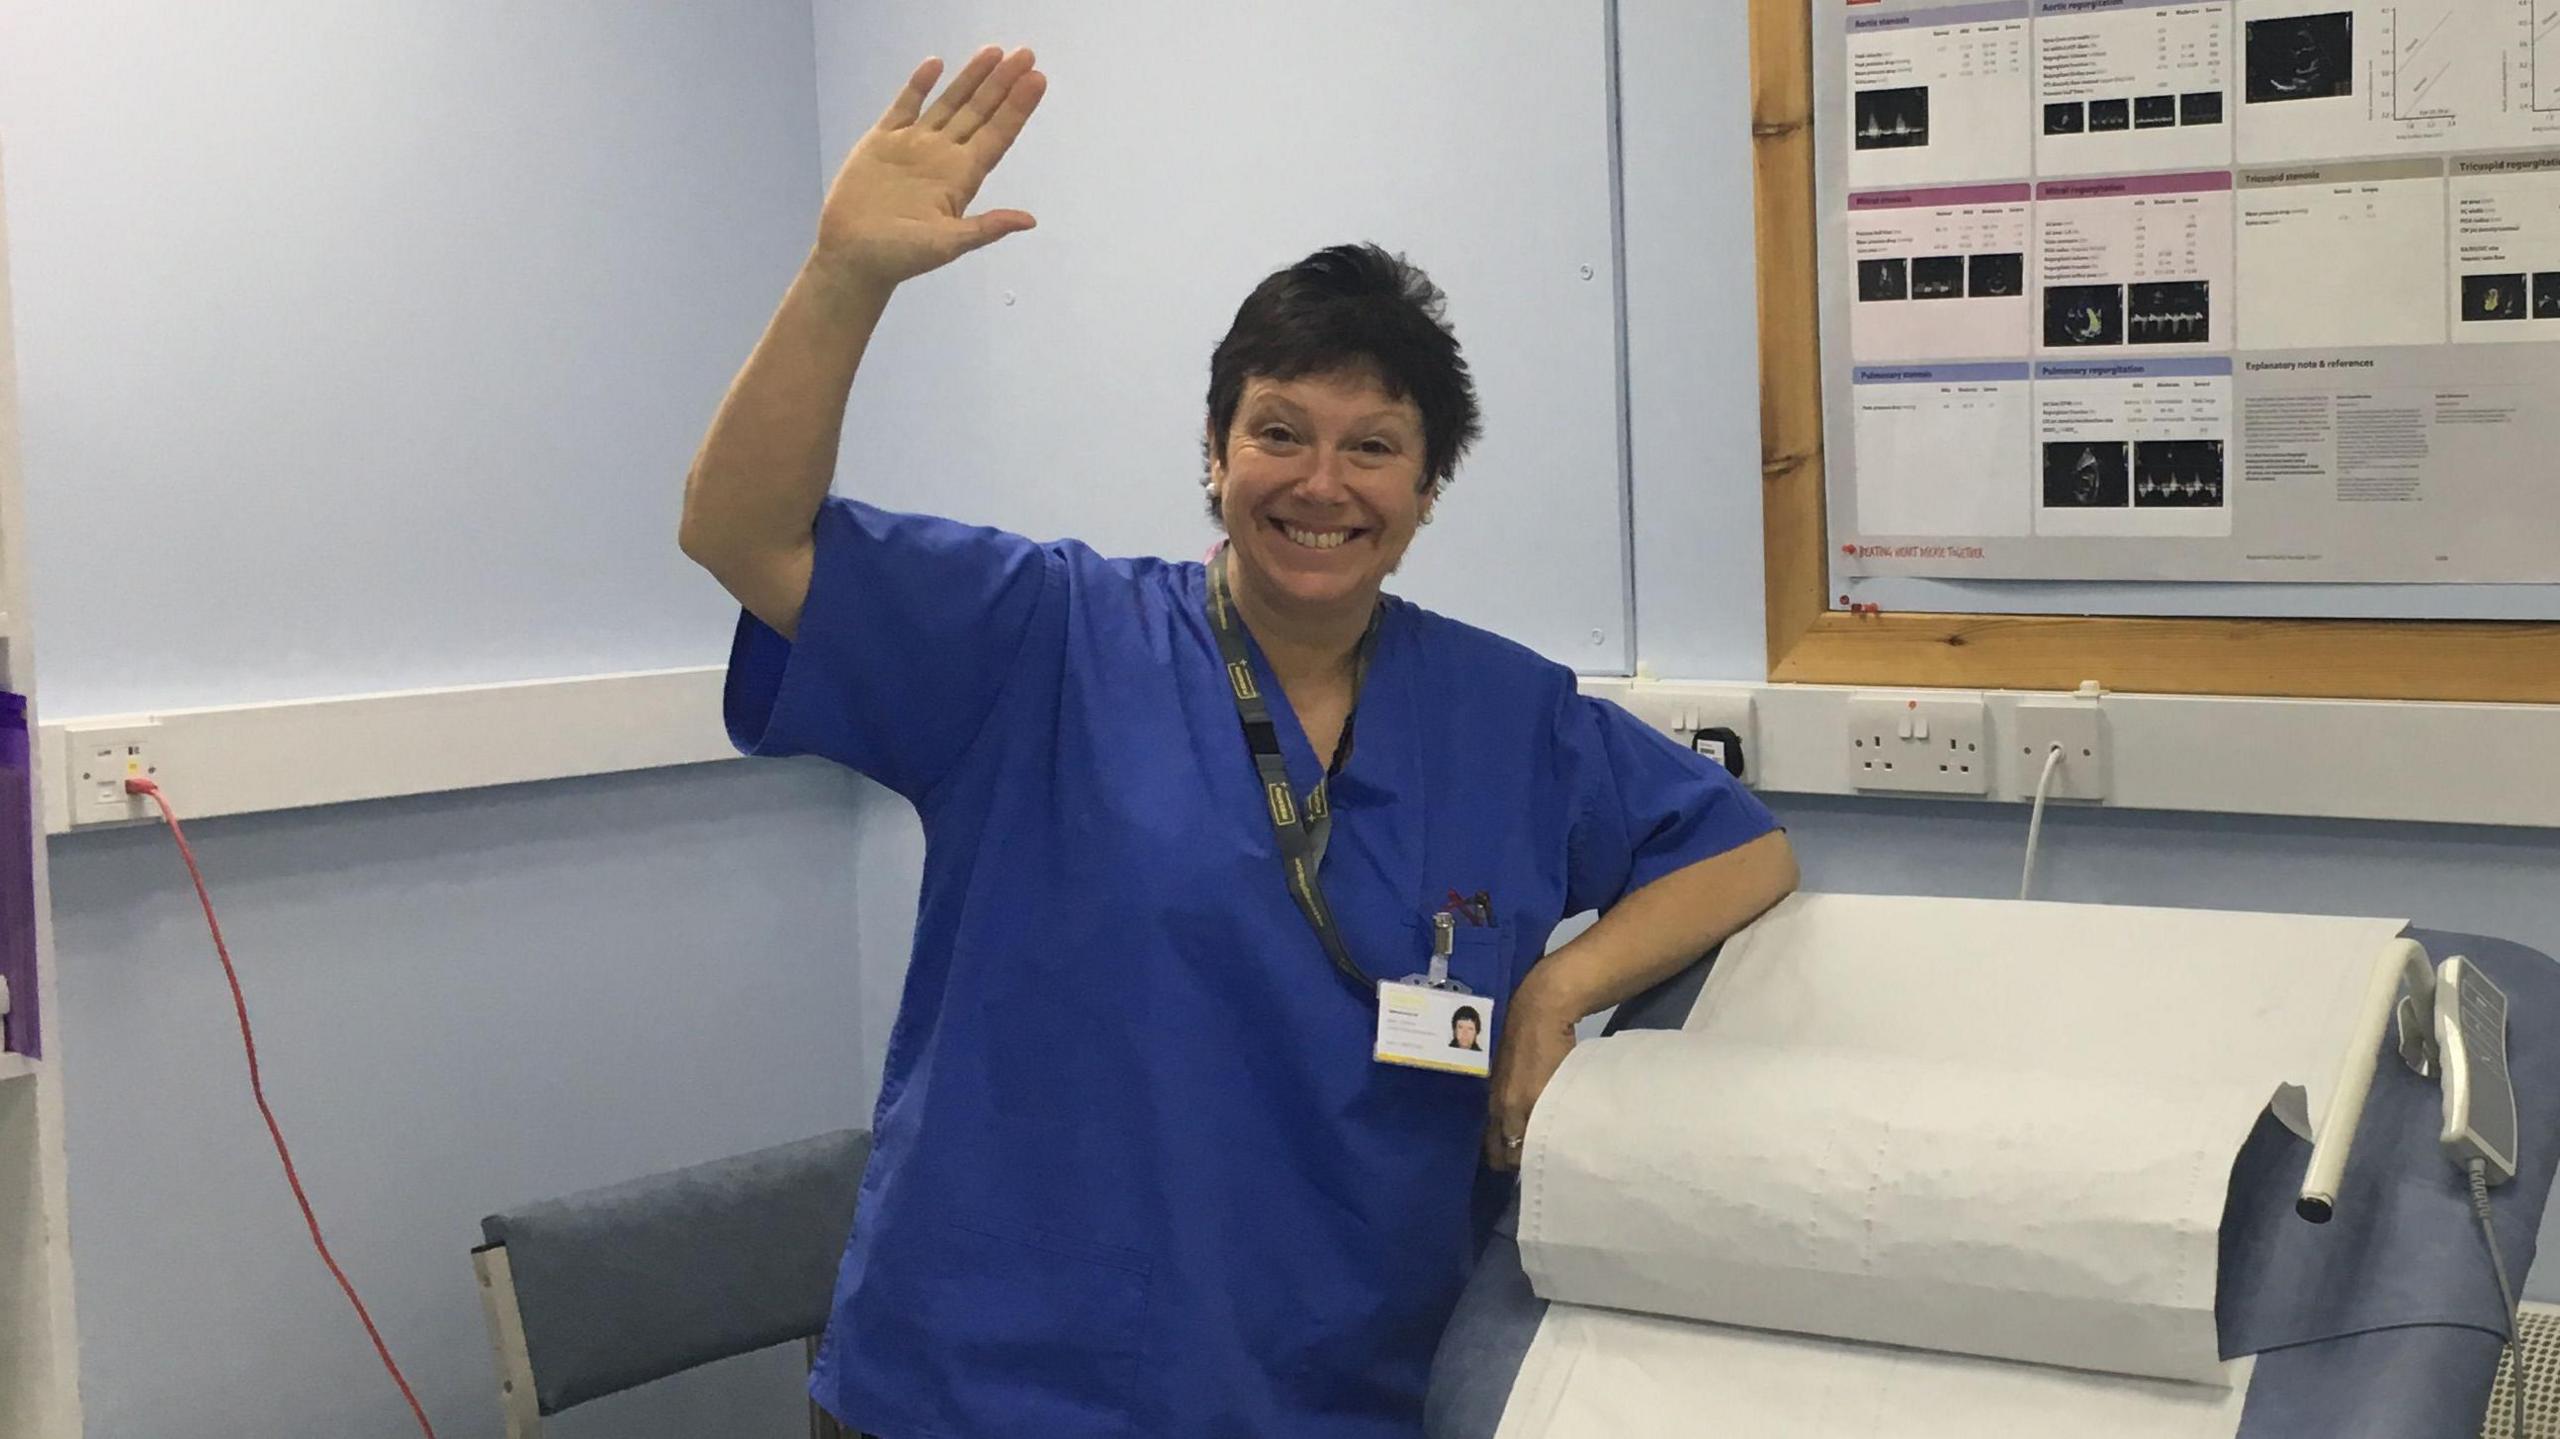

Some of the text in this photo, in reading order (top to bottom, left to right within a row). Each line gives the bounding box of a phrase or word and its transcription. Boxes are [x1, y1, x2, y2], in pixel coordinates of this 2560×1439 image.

[2042, 2, 2067, 12] Aortic
[2460, 161, 2505, 172] Tricuspid
[2245, 170, 2320, 184] Tricuspid stenosis
[2042, 364, 2145, 376] Pulmonary regurgitation
[2246, 358, 2374, 371] Explanatory note & references
